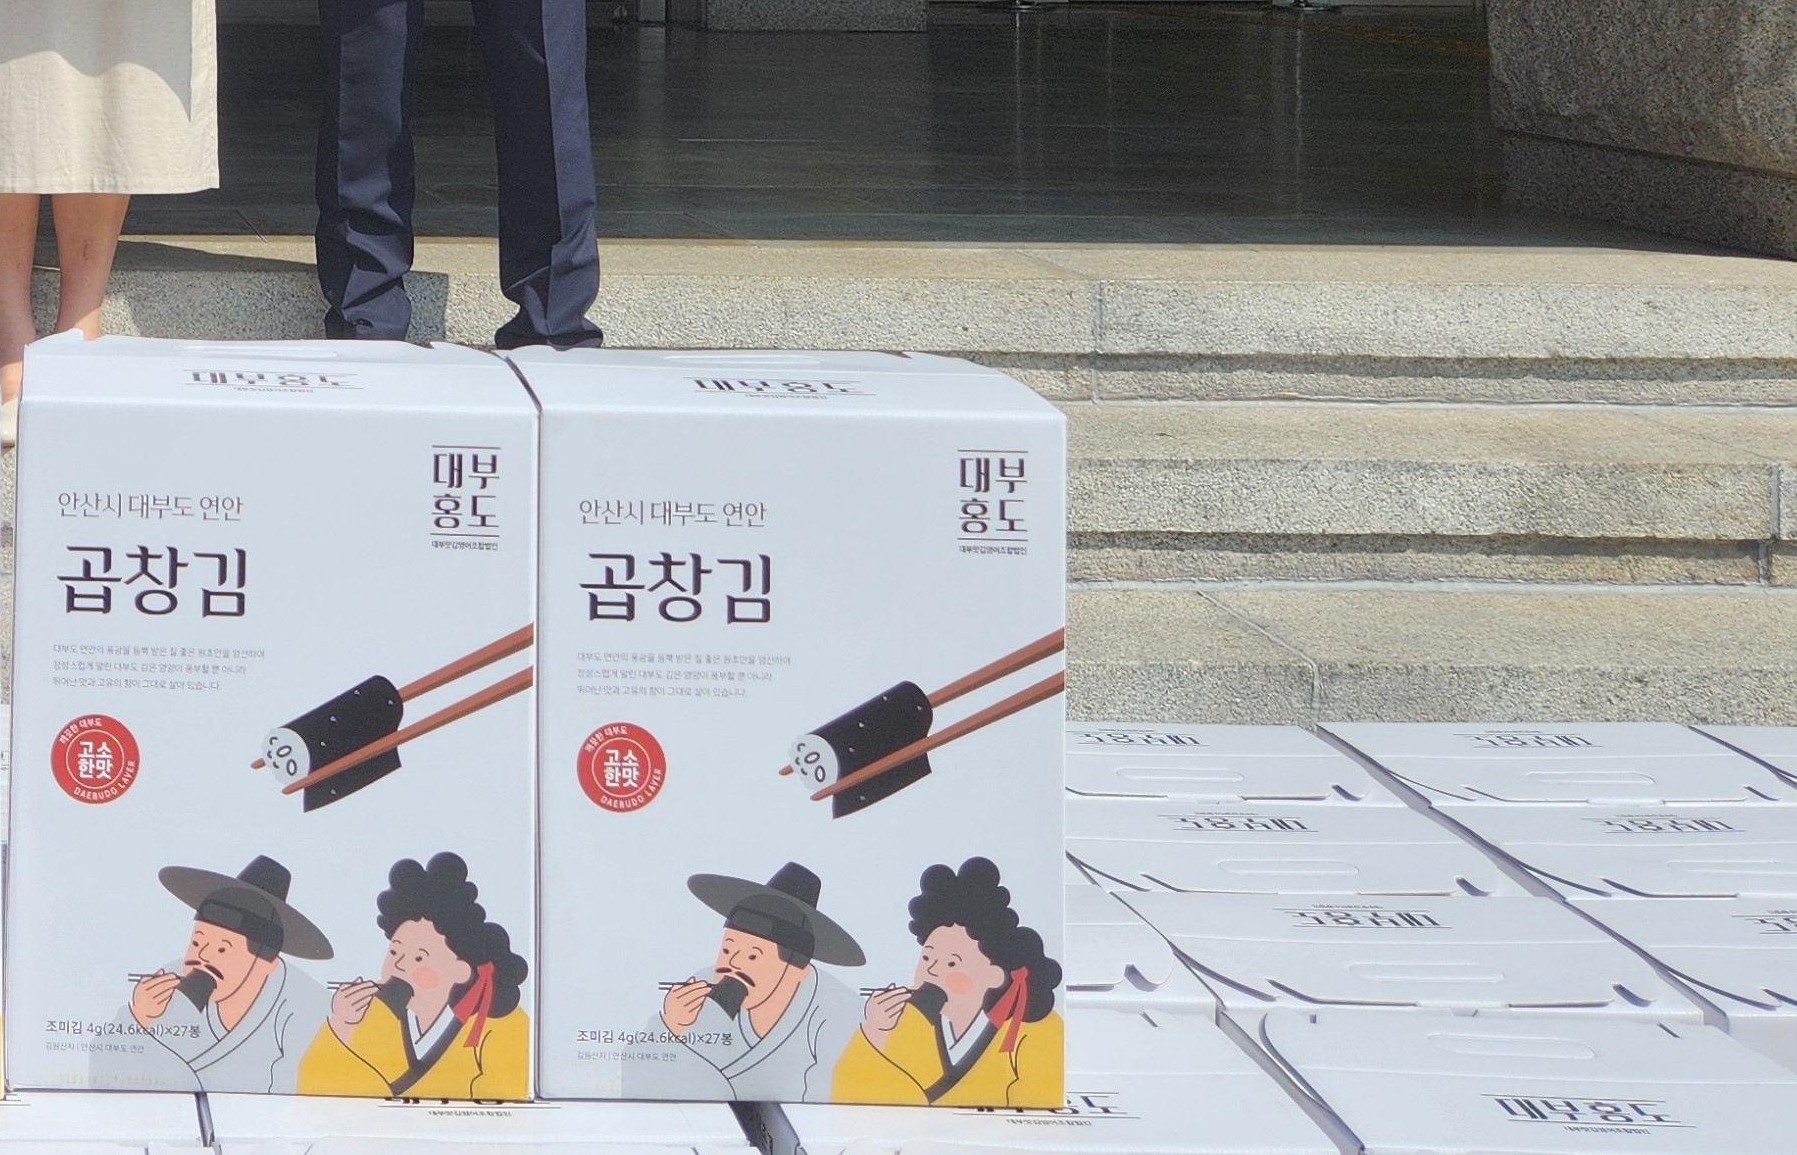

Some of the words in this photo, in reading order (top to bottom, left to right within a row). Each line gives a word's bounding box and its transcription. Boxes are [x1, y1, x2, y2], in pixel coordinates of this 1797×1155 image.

[433, 453, 501, 490] 대부
[960, 458, 1027, 493] 대부
[57, 491, 123, 519] 안산시
[129, 493, 195, 520] 대부도
[199, 494, 244, 522] 연안
[431, 494, 500, 530] 홍도
[579, 499, 644, 526] 안산시
[650, 501, 717, 526] 대부도
[722, 501, 767, 528] 연안
[959, 498, 1028, 534] 홍도
[56, 545, 247, 618] 곱창김
[579, 551, 772, 625] 곱창김
[78, 742, 113, 759] 고소
[604, 750, 639, 766] 고소
[74, 787, 117, 800] DAEBUDO
[118, 761, 135, 788] LAVER
[78, 759, 113, 779] 한맛
[604, 767, 639, 787] 한맛
[601, 795, 644, 808] DAEBUDO
[645, 769, 662, 796] LAVER
[46, 1021, 82, 1034] 조미김
[577, 1030, 613, 1043] 조미김
